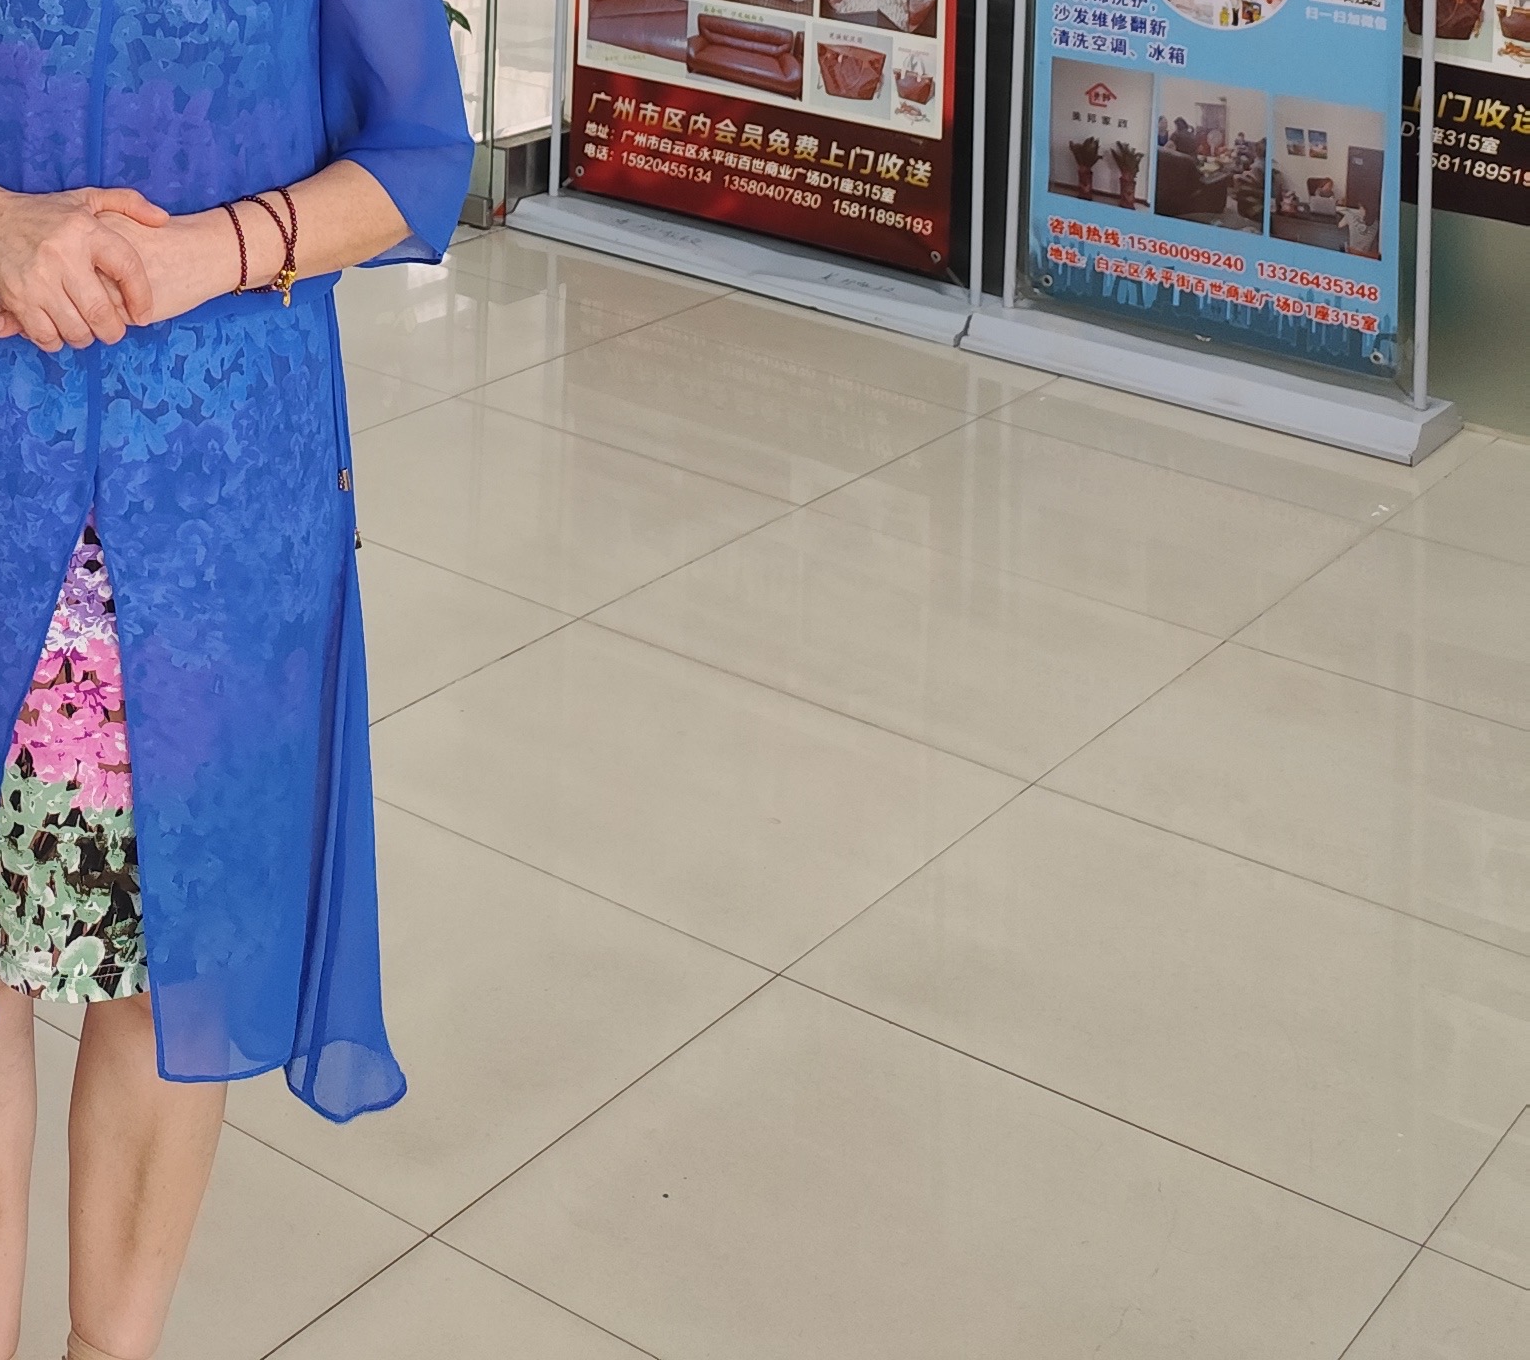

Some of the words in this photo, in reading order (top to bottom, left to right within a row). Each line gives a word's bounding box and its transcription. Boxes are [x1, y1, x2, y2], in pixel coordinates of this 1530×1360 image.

[1054, 4, 1166, 37] 沙发维修翻新
[588, 91, 932, 188] 广州市区内会员免费上门收送
[723, 174, 821, 210] 13580407830
[833, 198, 933, 236] 15811895193
[1257, 262, 1379, 301] 13326435348
